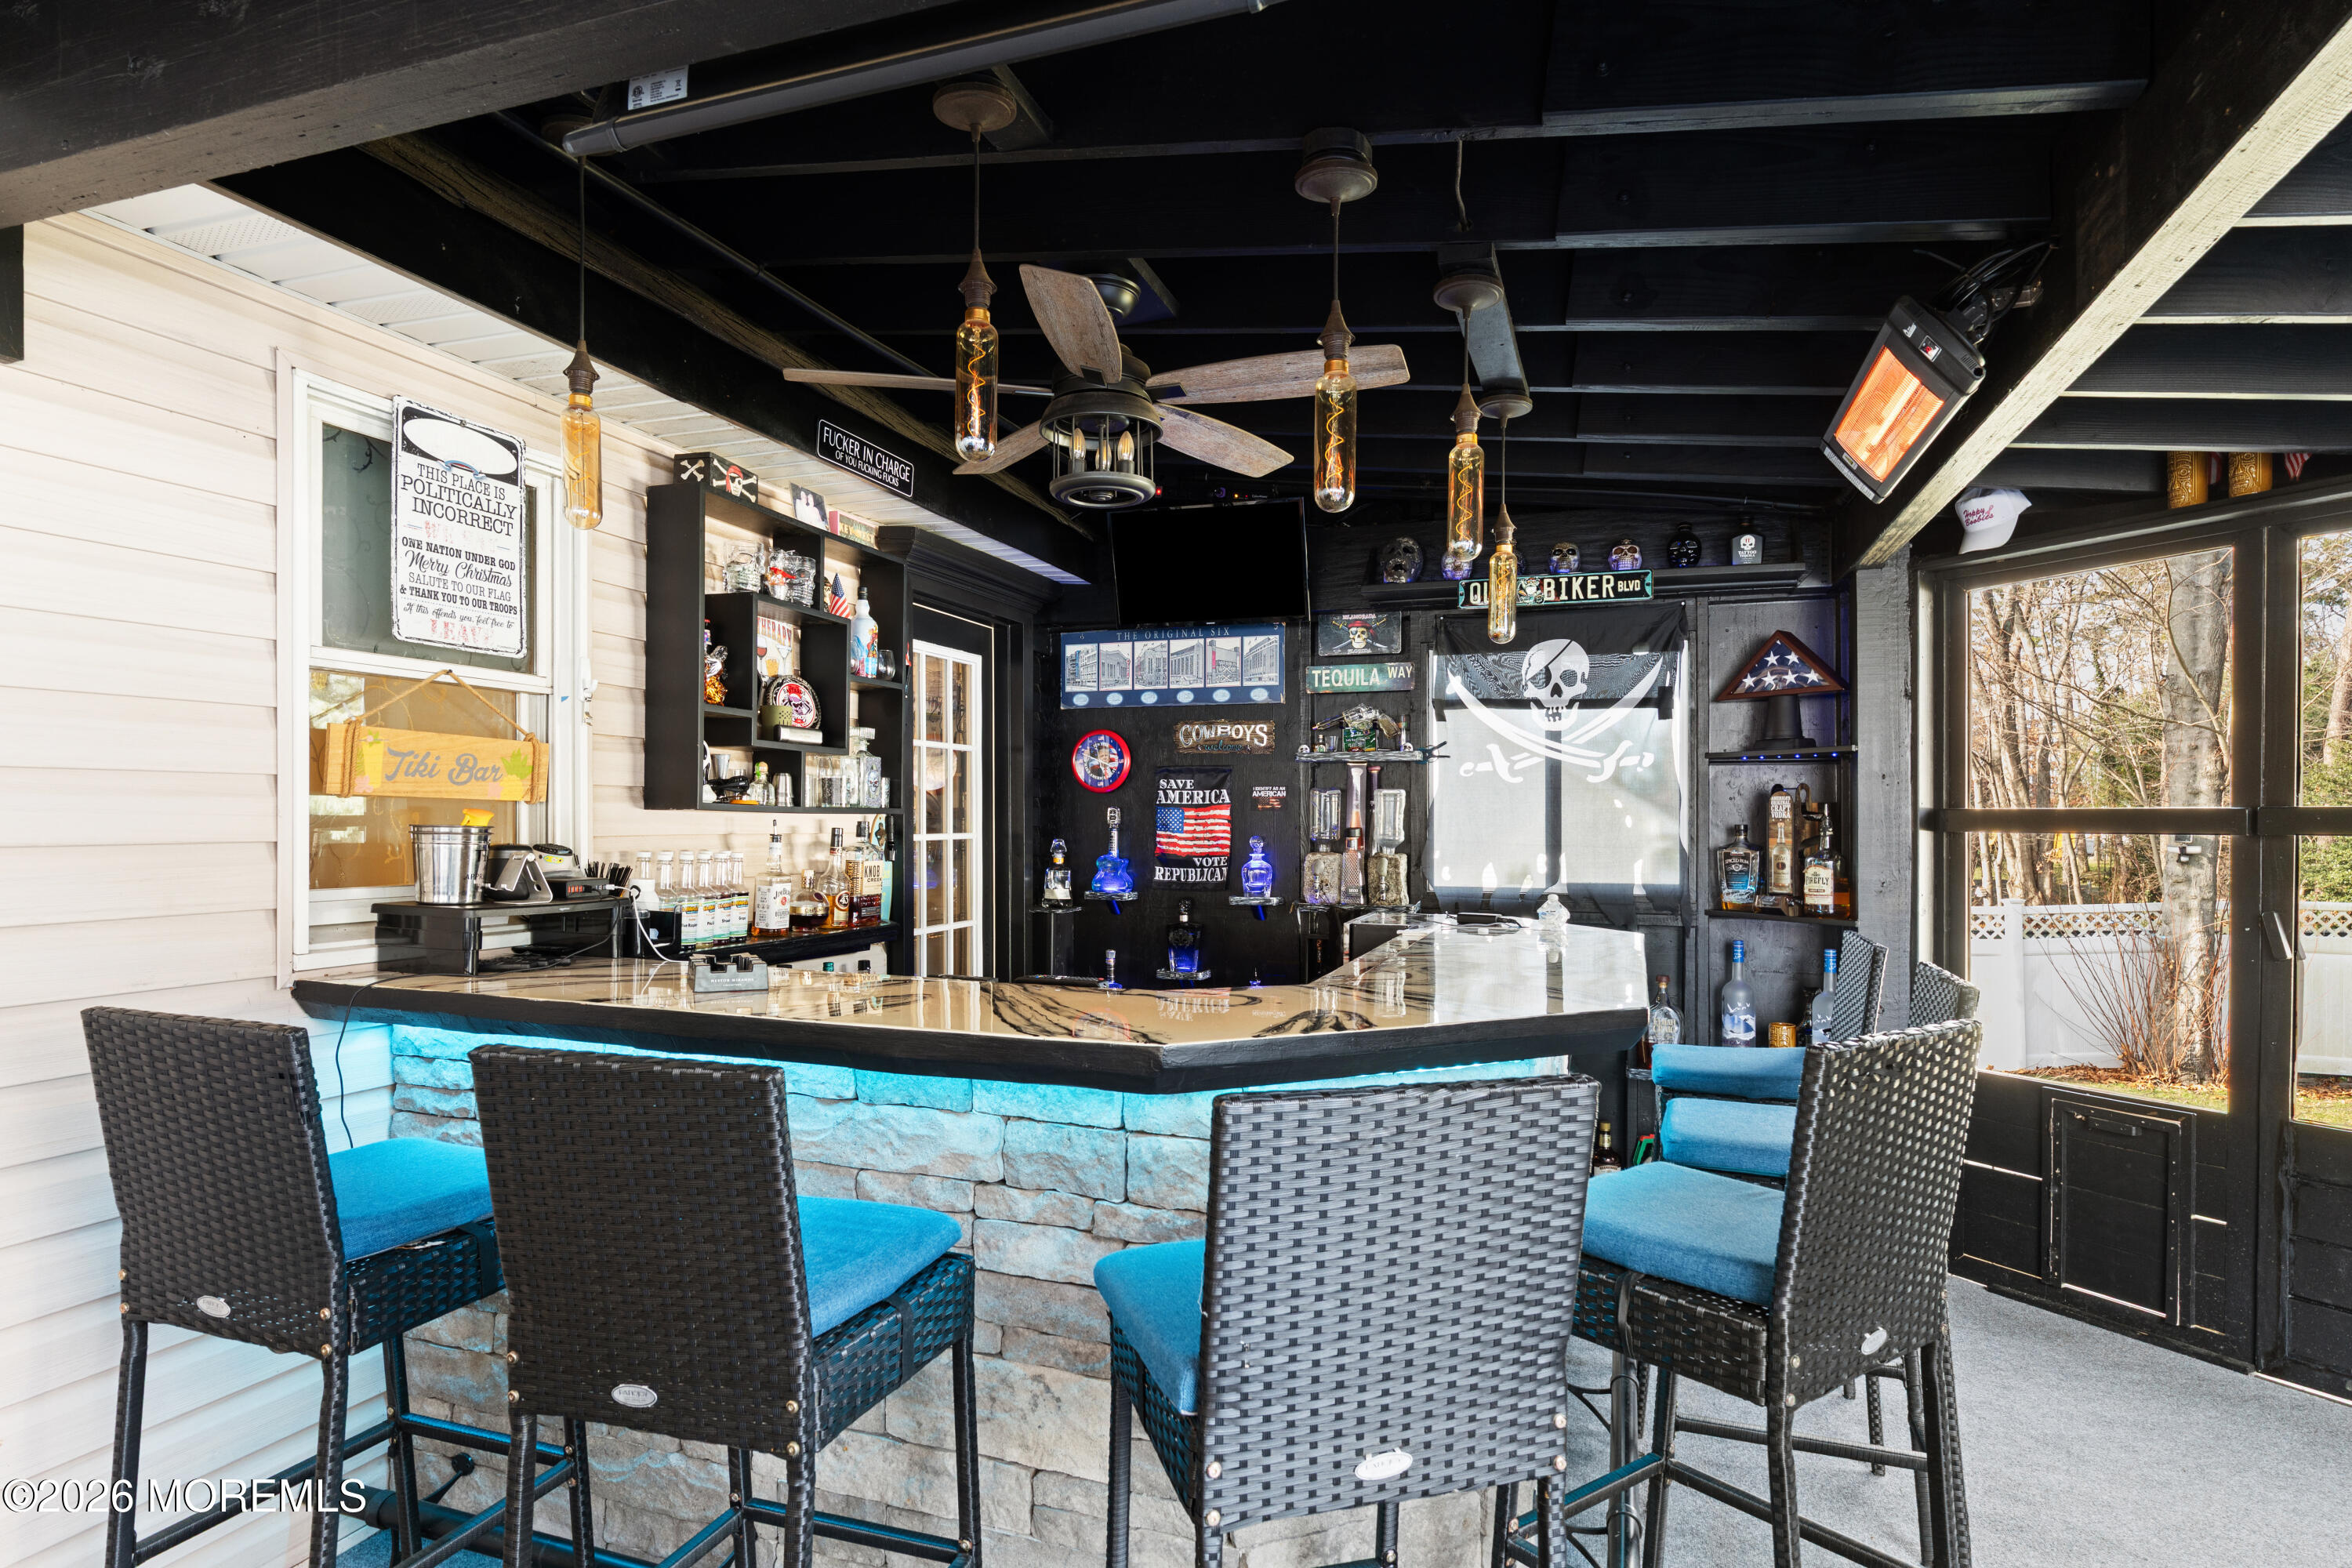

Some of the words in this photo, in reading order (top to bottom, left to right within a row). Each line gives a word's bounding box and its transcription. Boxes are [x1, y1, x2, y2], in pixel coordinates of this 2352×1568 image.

[824, 426, 859, 459] FUCKER
[862, 445, 873, 464] IN
[876, 452, 910, 482] CHARGE
[417, 463, 448, 484] THIS
[452, 474, 490, 496] PLACE
[494, 486, 506, 500] IS
[835, 450, 844, 461] OF
[845, 456, 857, 467] YOU
[858, 460, 881, 479] FUCKING
[883, 472, 899, 487] FUCKS
[401, 474, 517, 520] POLITICALLY
[412, 496, 514, 536] INCORRECT
[402, 536, 423, 550] ONE
[426, 542, 462, 559] NATION
[465, 551, 496, 567] UNDER
[499, 559, 516, 571] GOD
[405, 550, 449, 576] Merry
[455, 561, 512, 587] Christmas
[400, 584, 406, 594] &
[409, 586, 439, 601] THANK
[441, 592, 457, 604] YOU
[459, 596, 470, 606] TO
[472, 598, 488, 609] OUR
[489, 601, 517, 615] TROOPS
[408, 572, 448, 590] SALUTE
[452, 580, 463, 592] TO
[466, 583, 485, 597] OUR
[488, 588, 511, 601] FLAG
[1469, 583, 1489, 604] OL
[1544, 575, 1615, 601] BIKER
[1617, 579, 1641, 593] BLVD
[416, 601, 429, 615] this
[432, 608, 456, 619] offends
[475, 615, 489, 626] feel
[488, 618, 504, 628] free
[506, 620, 514, 629] to
[757, 617, 791, 647] THERAPY
[1116, 632, 1138, 641] THE
[1145, 628, 1203, 639] ORIGINAL
[1210, 627, 1230, 637] SIX
[1312, 668, 1380, 688] TEQUILA
[1388, 666, 1413, 678] WAY
[1179, 724, 1268, 746] COWBOYS
[1203, 740, 1242, 751] welcome
[385, 746, 441, 782] Tiki
[448, 753, 503, 786] Bar
[1156, 789, 1230, 804] AMERICA
[1160, 779, 1194, 789] SAVE
[864, 865, 880, 878] KNOB
[1154, 866, 1228, 882] REPUBLICAN
[1193, 856, 1228, 866] VOTE
[1806, 876, 1829, 886] FIREFLY
[840, 895, 848, 905] 43
